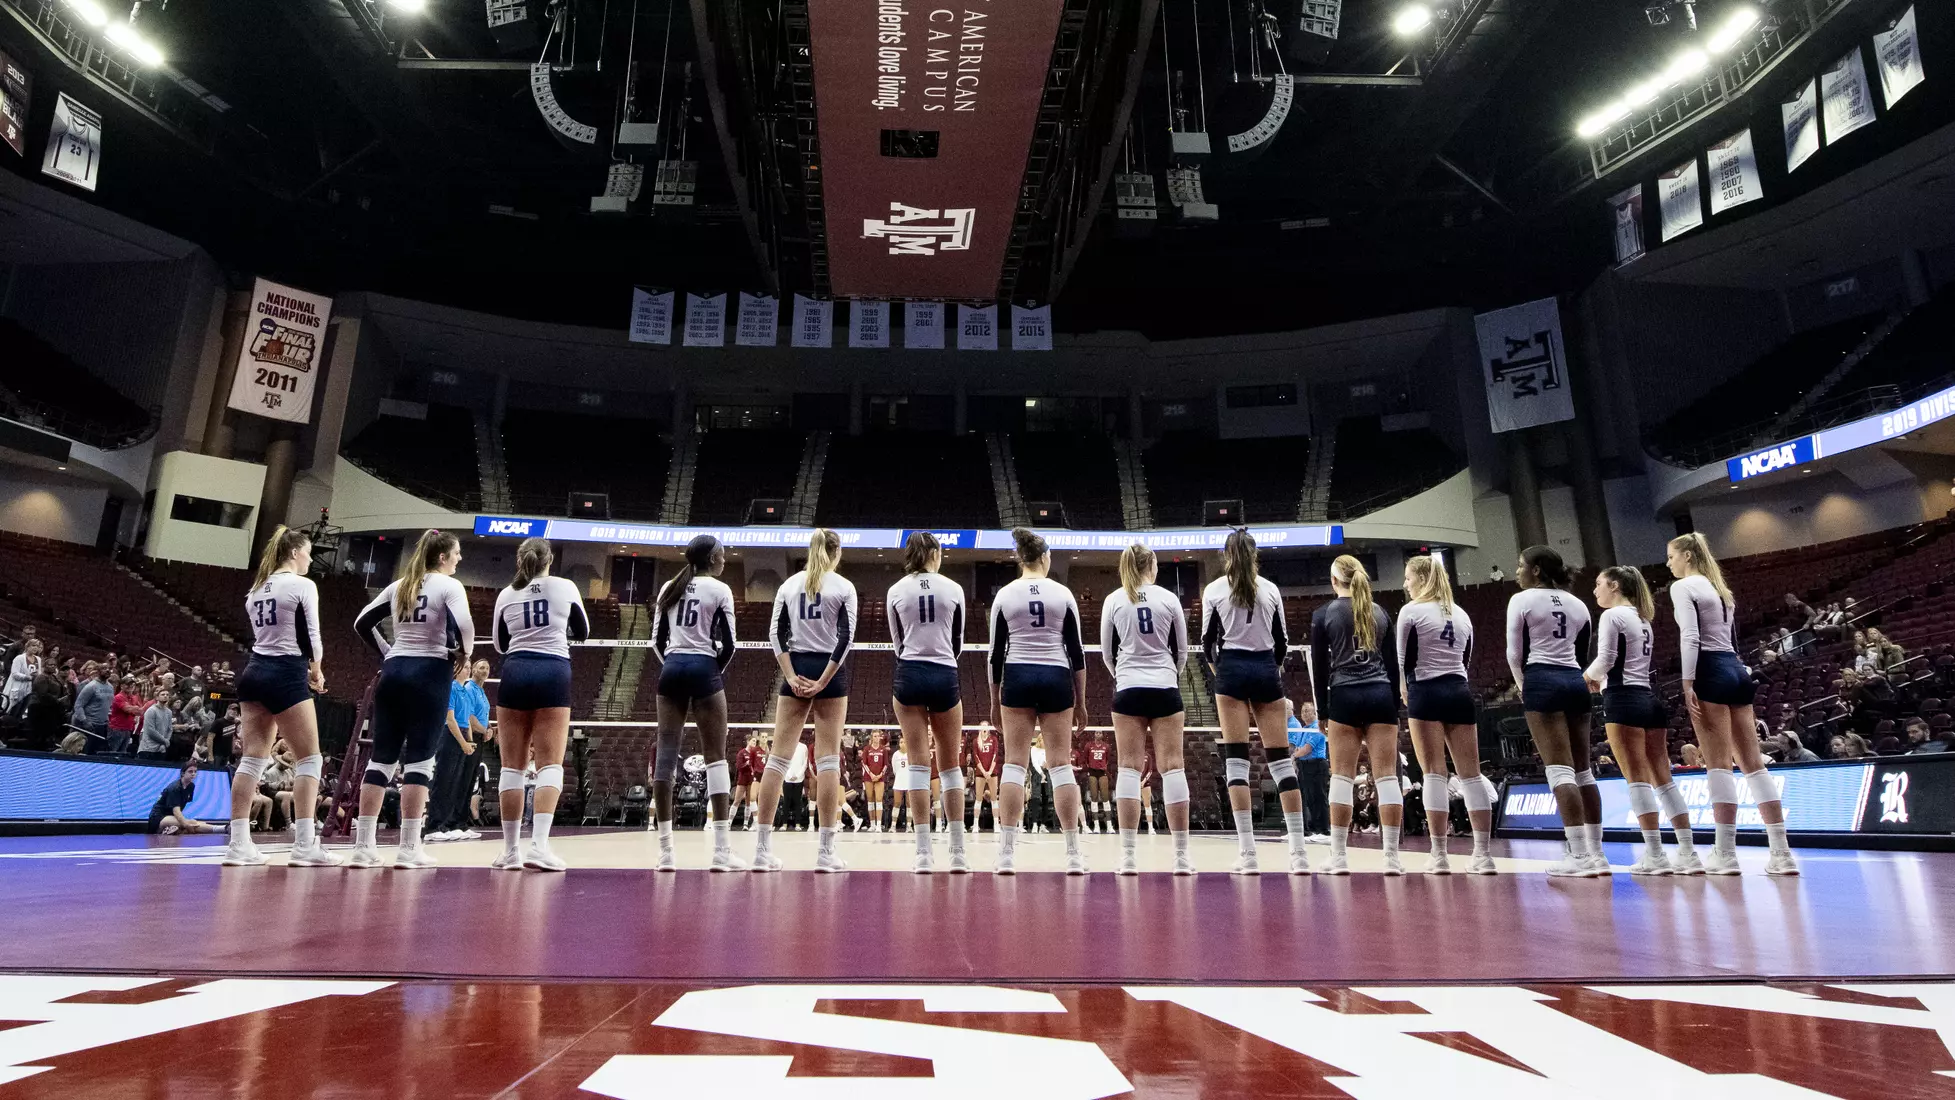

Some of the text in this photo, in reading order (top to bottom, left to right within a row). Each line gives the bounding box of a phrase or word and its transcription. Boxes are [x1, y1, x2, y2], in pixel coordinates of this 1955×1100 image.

[878, 46, 908, 73] love
[922, 9, 955, 111] CAMPUS
[954, 9, 988, 111] AMERICAN
[70, 144, 82, 157] 23
[1670, 185, 1687, 199] 2018
[1721, 175, 1743, 191] 2007
[1723, 186, 1744, 201] 2016
[257, 301, 321, 328] CHAMPIONS
[266, 292, 317, 315] NATIONAL
[272, 326, 313, 350] FINAL
[964, 324, 991, 336] 2012
[1018, 325, 1045, 337] 2015
[254, 368, 298, 393] 2011
[1881, 407, 1918, 437] 2019
[1740, 443, 1797, 478] NCAA
[488, 520, 531, 535] NCAA
[617, 528, 661, 541] DIVISION
[723, 531, 781, 543] VOLLEYBALL
[1098, 535, 1145, 546] WOMEN'S
[1147, 534, 1206, 547] VOLLEYBALL
[253, 598, 278, 628] 33
[519, 598, 548, 628] 18
[676, 598, 699, 627] 16
[800, 592, 822, 620] 12
[918, 594, 936, 624] 11
[1028, 600, 1045, 628] 9
[1137, 607, 1154, 634] 8
[1552, 611, 1567, 640] 3
[1439, 620, 1456, 648] 4
[1641, 628, 1651, 656] 2
[873, 755, 879, 763] 8
[900, 760, 906, 768] 9
[1093, 752, 1103, 760] 22
[1504, 792, 1558, 816] OKLAHOMA
